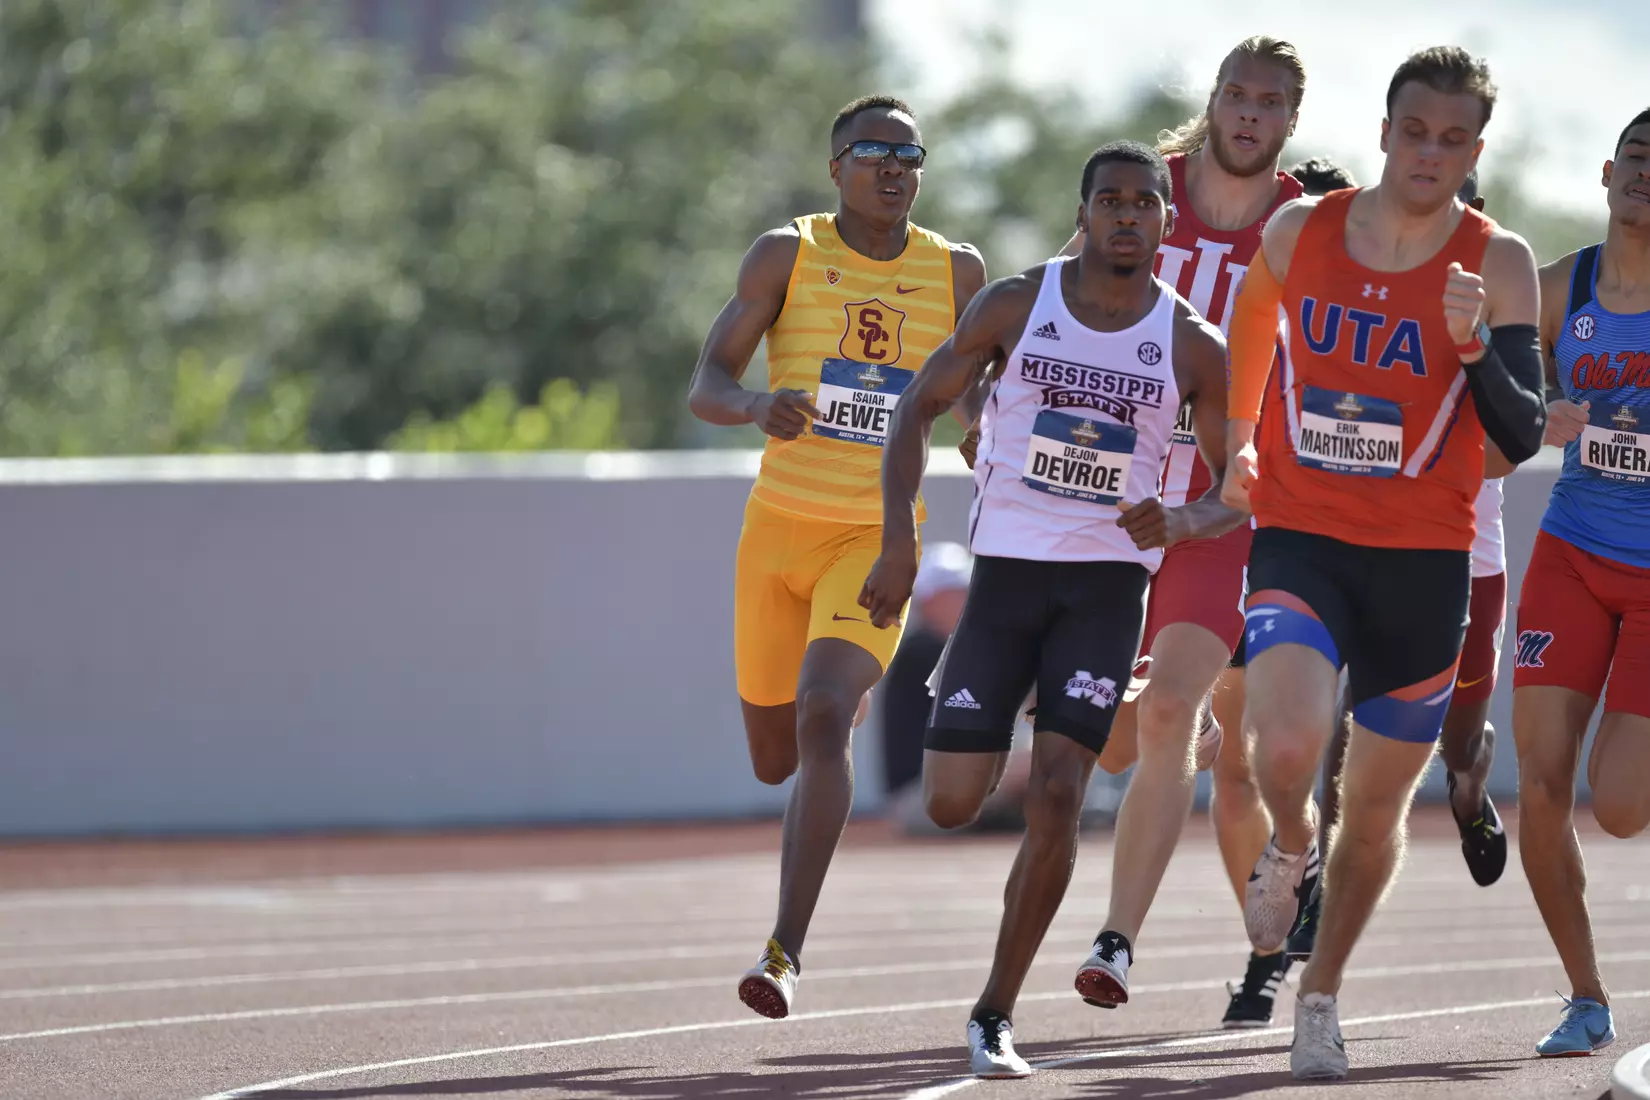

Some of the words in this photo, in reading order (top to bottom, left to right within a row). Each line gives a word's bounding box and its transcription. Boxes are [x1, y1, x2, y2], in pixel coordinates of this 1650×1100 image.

[857, 308, 889, 360] SC
[1032, 331, 1061, 342] adidas
[1301, 295, 1428, 378] UTA
[1573, 315, 1595, 340] SEC
[1140, 344, 1161, 364] SEC
[1020, 357, 1165, 404] MISSISSIPPI
[1572, 351, 1617, 390] Ole
[852, 391, 886, 406] ISAIAH
[1057, 393, 1121, 415] STATE
[1336, 422, 1361, 435] ERIK
[1611, 433, 1637, 446] JOHN
[1063, 445, 1099, 463] DEJON
[1300, 427, 1400, 463] MARTINSSON
[1588, 440, 1650, 473] RIVER
[1031, 451, 1122, 492] DEVROE
[1073, 679, 1111, 700] STATE
[944, 700, 981, 709] adidas
